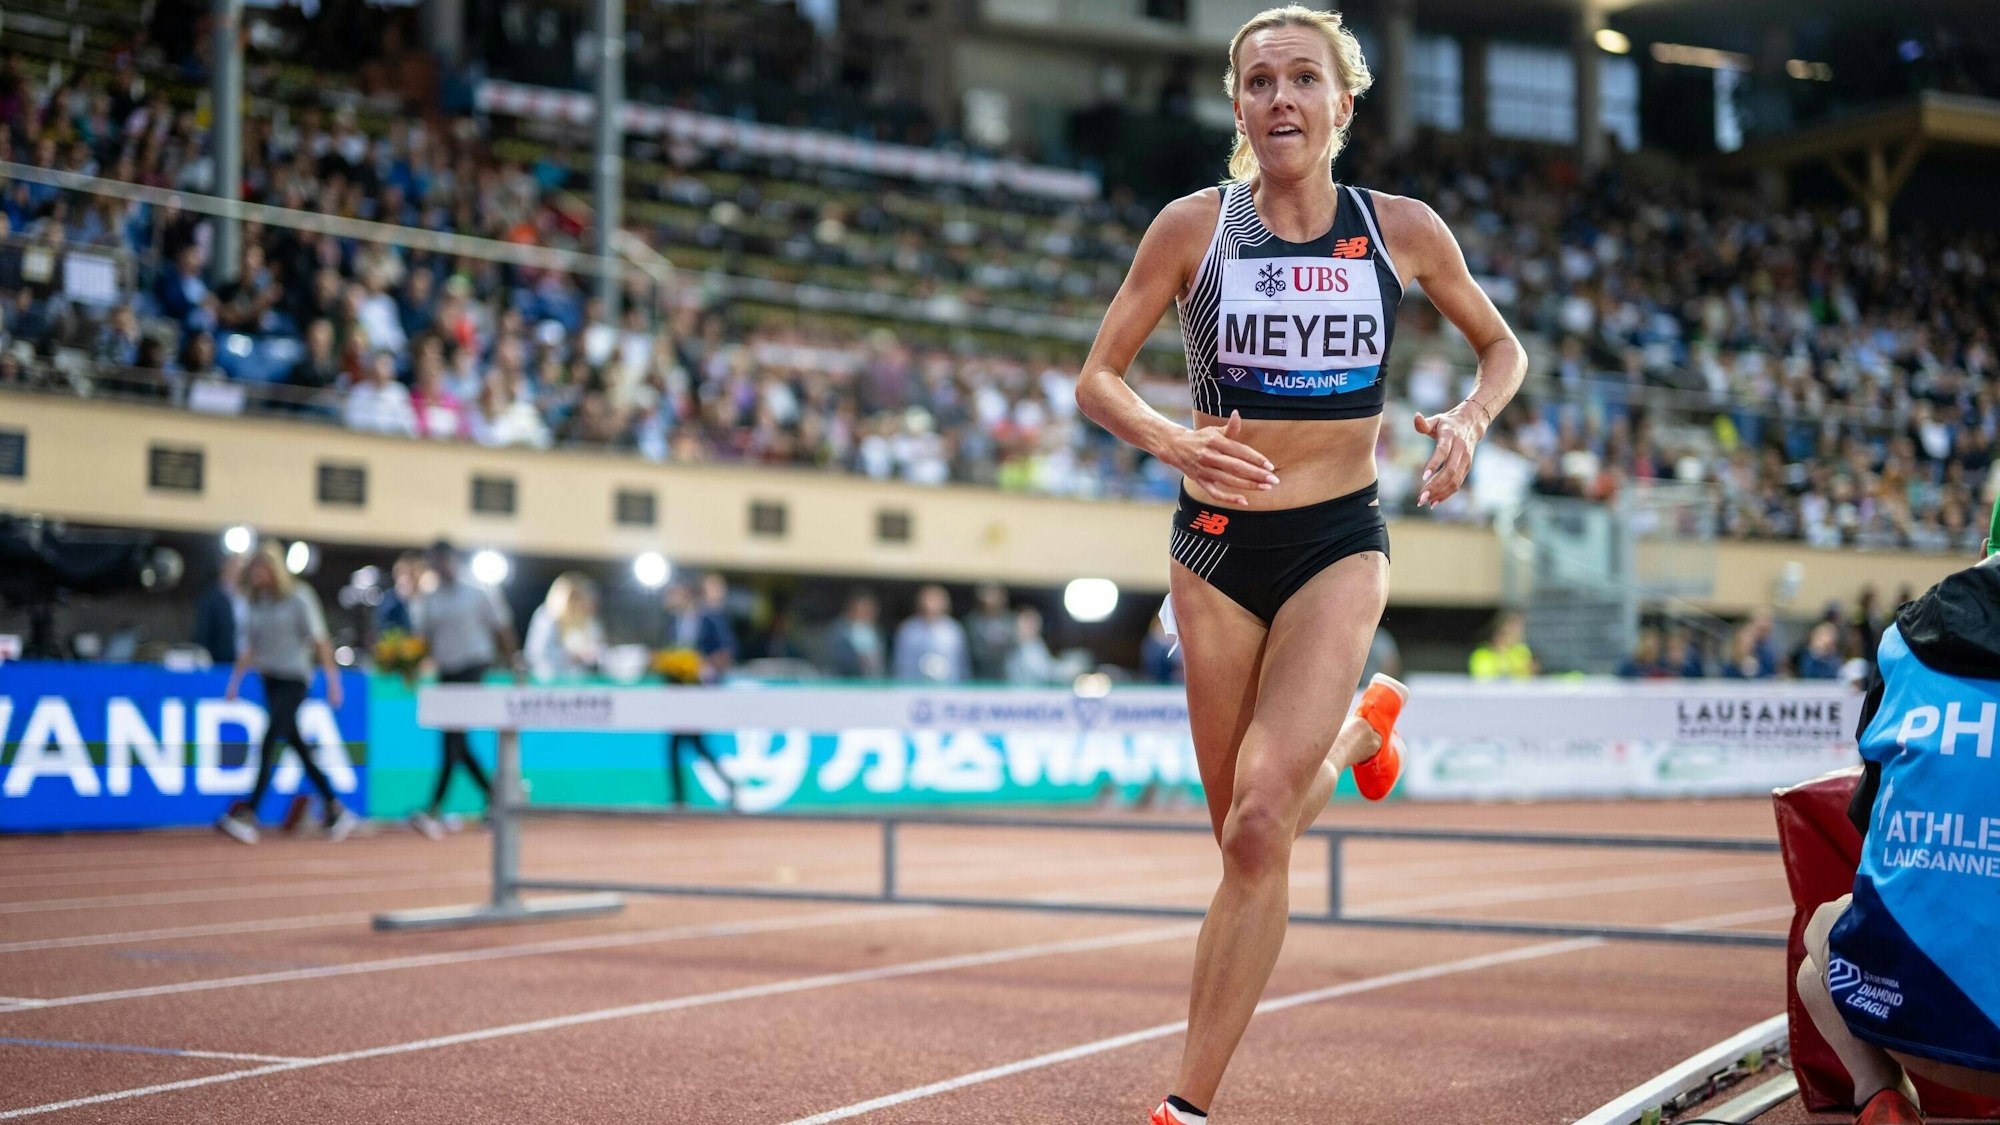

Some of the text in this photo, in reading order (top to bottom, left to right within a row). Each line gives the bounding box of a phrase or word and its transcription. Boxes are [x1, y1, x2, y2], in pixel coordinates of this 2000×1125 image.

[1291, 267, 1349, 292] UBS
[1225, 313, 1378, 357] MEYER
[1263, 372, 1349, 389] LAUSANNE
[1189, 511, 1230, 536] NB
[1677, 700, 1843, 722] LAUSANNE
[1896, 701, 1997, 758] PH
[0, 696, 358, 798] ANDA
[1885, 810, 2000, 851] ATHLE
[1883, 847, 2000, 878] LAUSANNE
[1845, 993, 1890, 1019] LEAGUE
[1857, 983, 1904, 1006] DIAMOND
